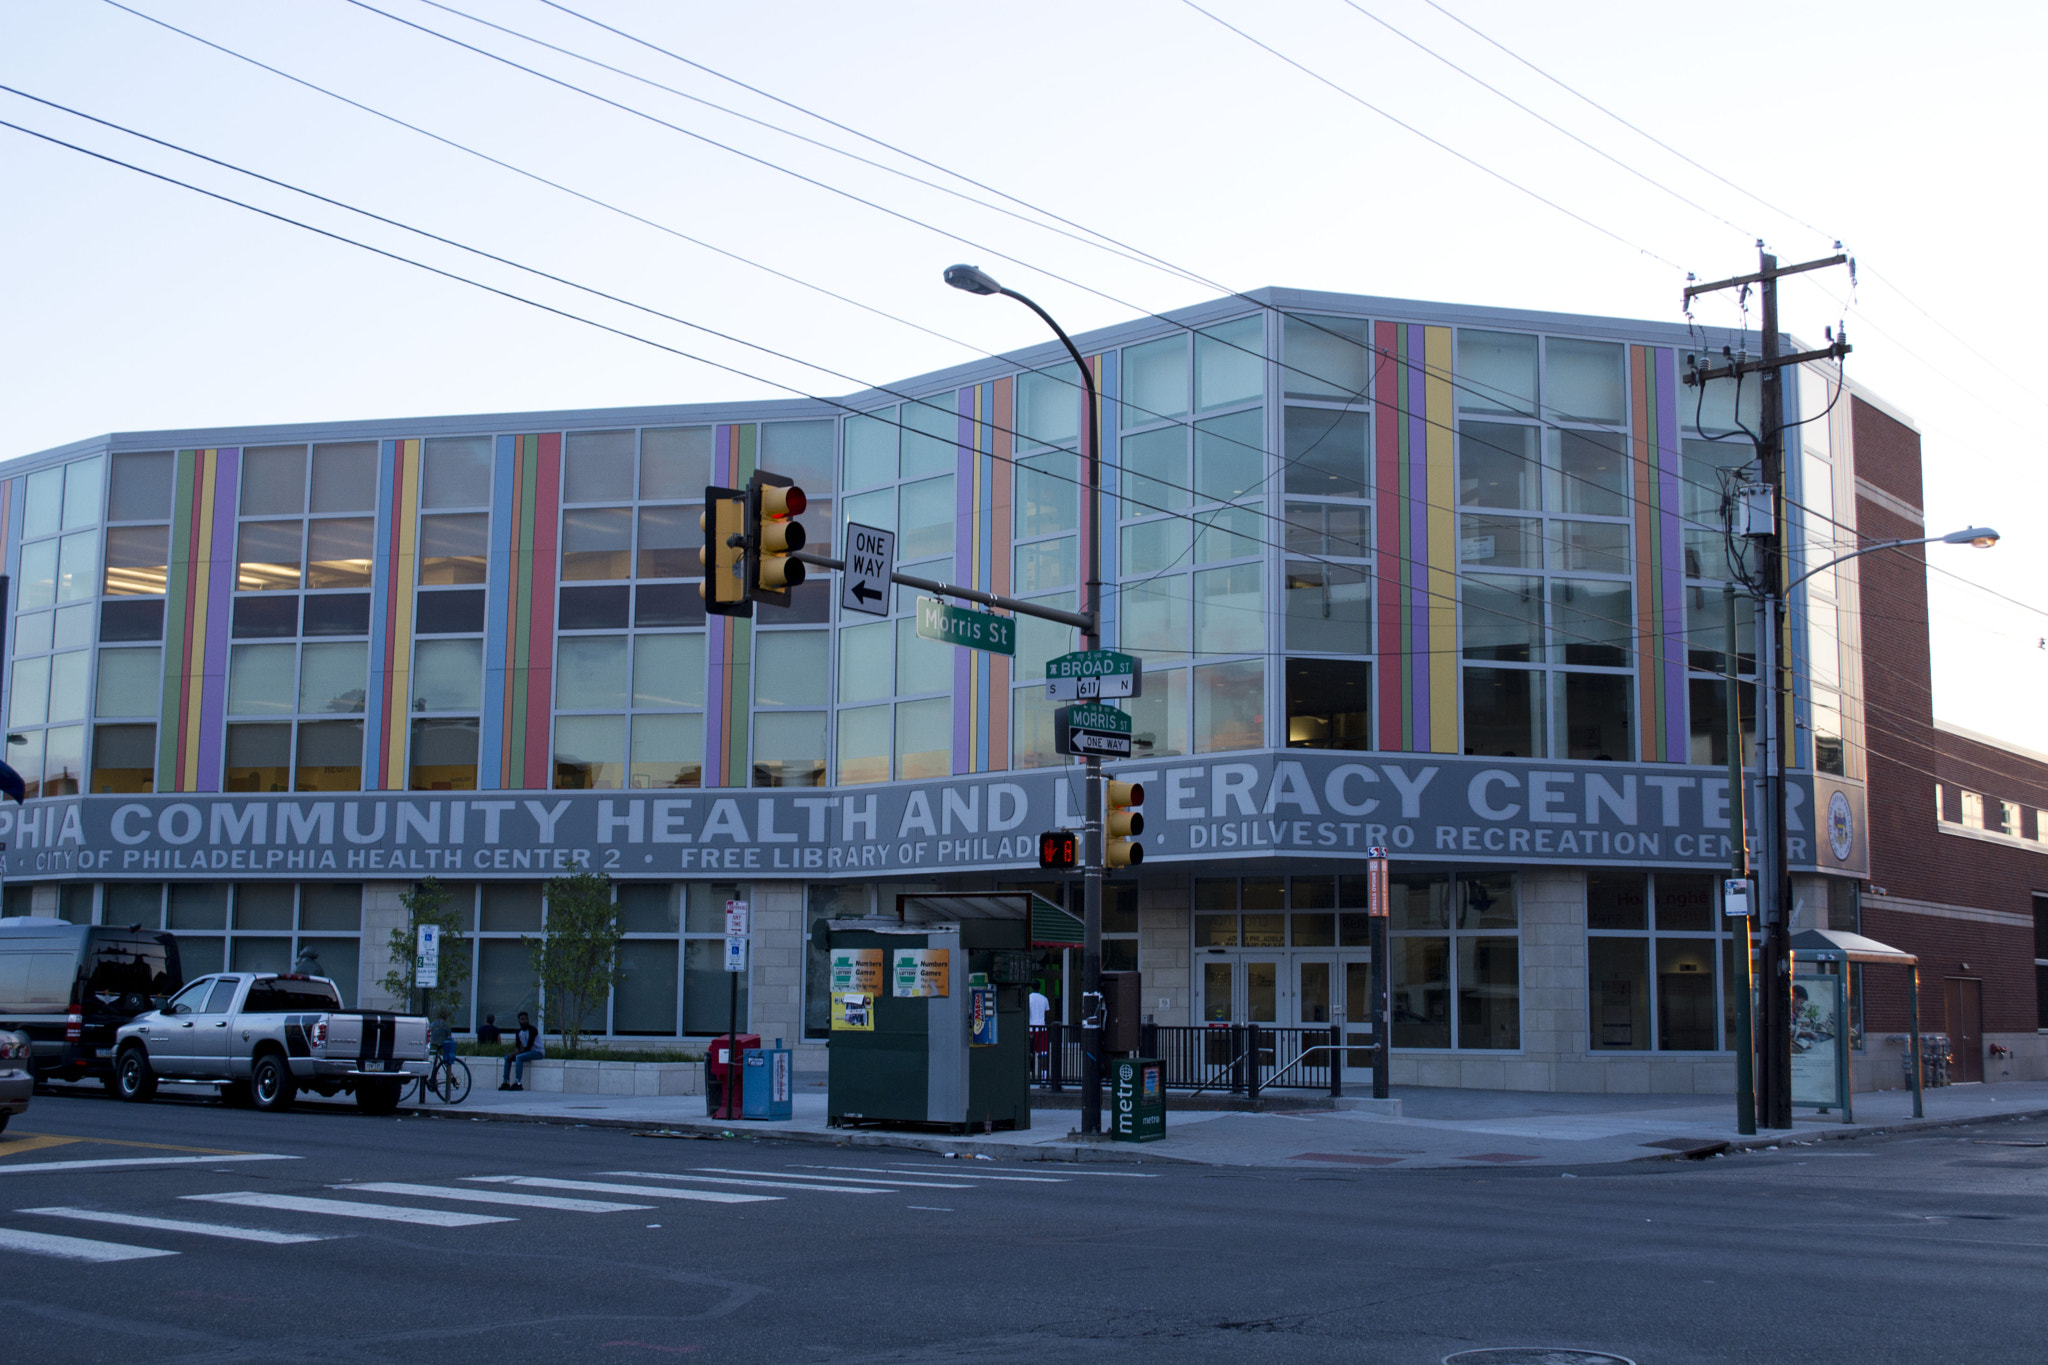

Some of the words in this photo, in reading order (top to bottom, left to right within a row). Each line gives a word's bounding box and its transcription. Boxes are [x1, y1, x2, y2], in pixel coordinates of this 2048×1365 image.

[856, 532, 885, 556] ONE
[853, 555, 884, 579] WAY
[925, 607, 981, 640] Morris
[989, 622, 1008, 646] St
[1061, 659, 1114, 677] BROAD
[1119, 662, 1130, 673] ST
[1049, 684, 1056, 694] S
[1080, 682, 1096, 694] 611
[1121, 680, 1128, 690] N
[1073, 710, 1116, 730] MORRIS
[1120, 720, 1128, 731] ST
[1086, 736, 1103, 748] ONE
[1106, 738, 1123, 750] WAY
[110, 799, 572, 845] COMMUNITY
[597, 794, 877, 844] HEALTH
[898, 783, 1028, 839] AND
[35, 851, 74, 871] CITY
[79, 849, 113, 869] OF
[123, 849, 336, 869] PHILADELPHIA
[348, 849, 462, 869] HEALTH
[474, 849, 592, 869] CENTER
[604, 849, 621, 869] 2
[681, 848, 761, 869] FREE
[766, 842, 892, 869] LIBRARY
[898, 841, 928, 864] OF
[1189, 820, 1414, 849] DISILVESTRO
[1436, 825, 1660, 856] RECREATION
[920, 969, 941, 977] Games
[1116, 1063, 1133, 1134] metro
[1142, 1115, 1160, 1125] metro
